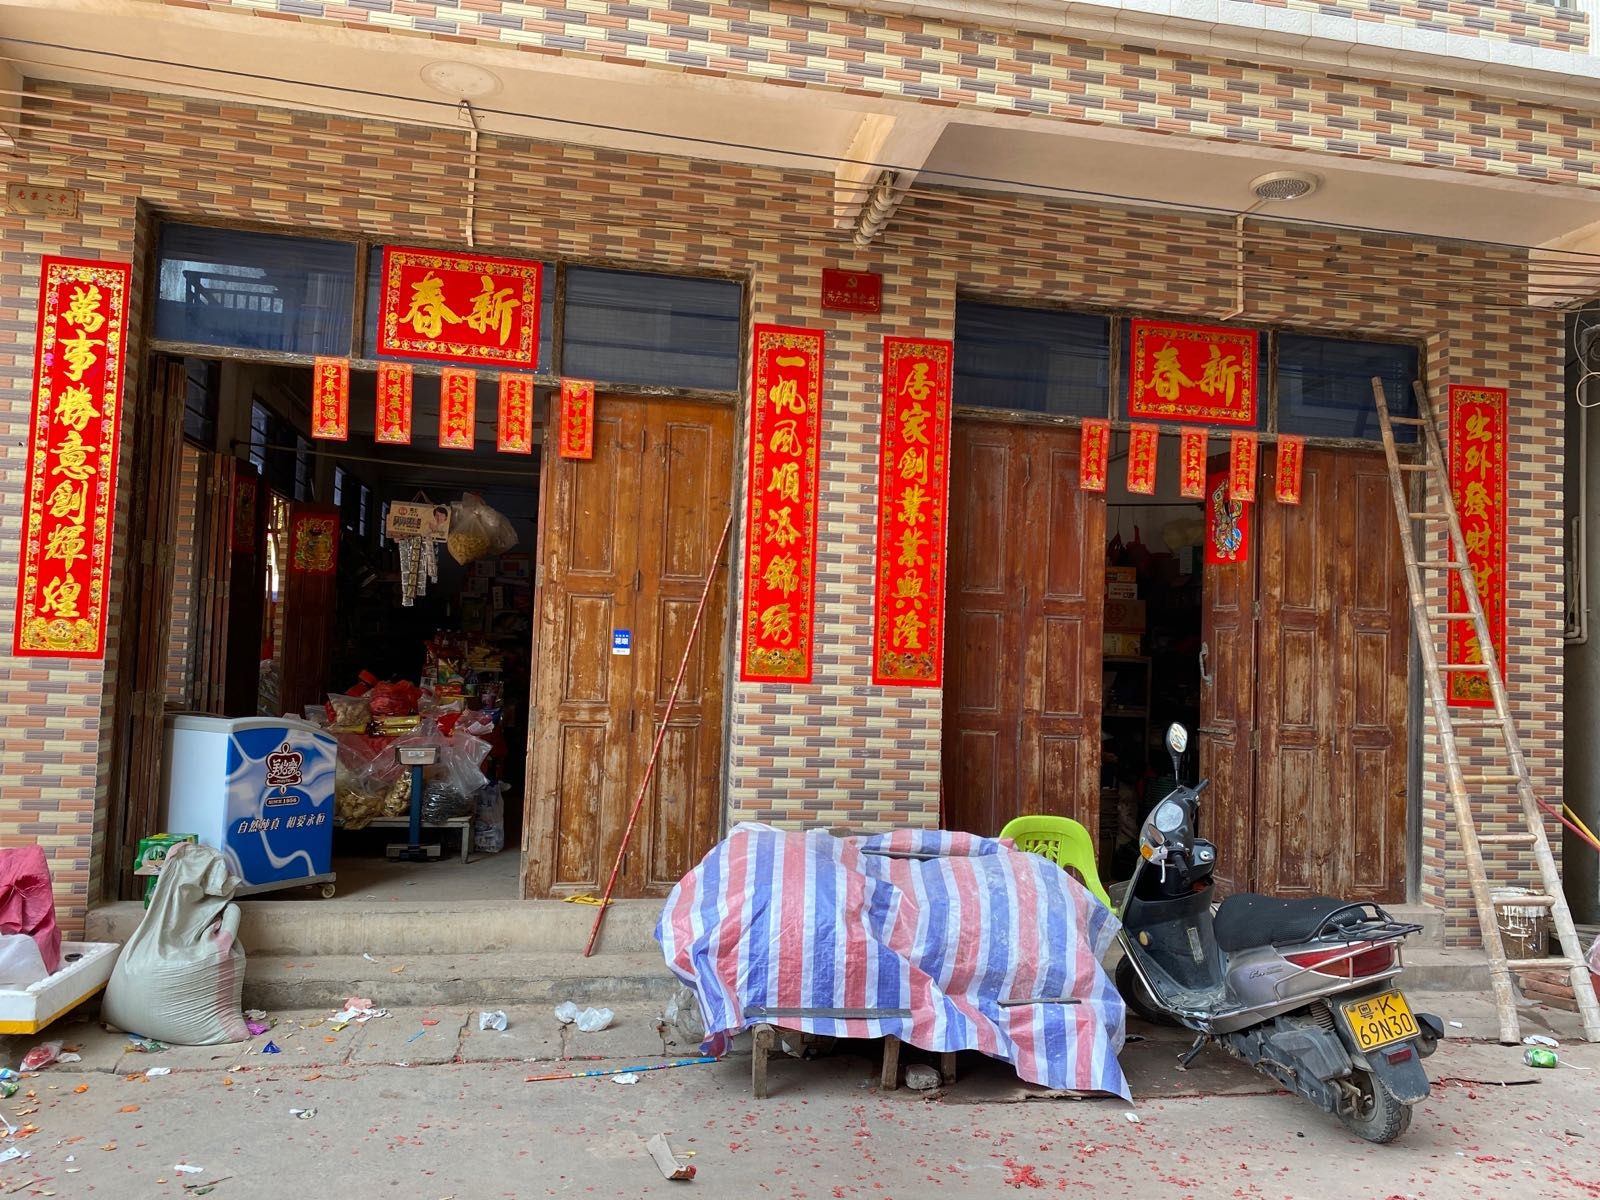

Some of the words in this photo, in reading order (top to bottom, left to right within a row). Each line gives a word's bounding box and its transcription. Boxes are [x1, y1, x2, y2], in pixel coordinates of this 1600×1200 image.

[448, 376, 468, 430] 大吉大利
[1186, 435, 1201, 481] 大吉大利
[1360, 1012, 1413, 1045] 69N30
